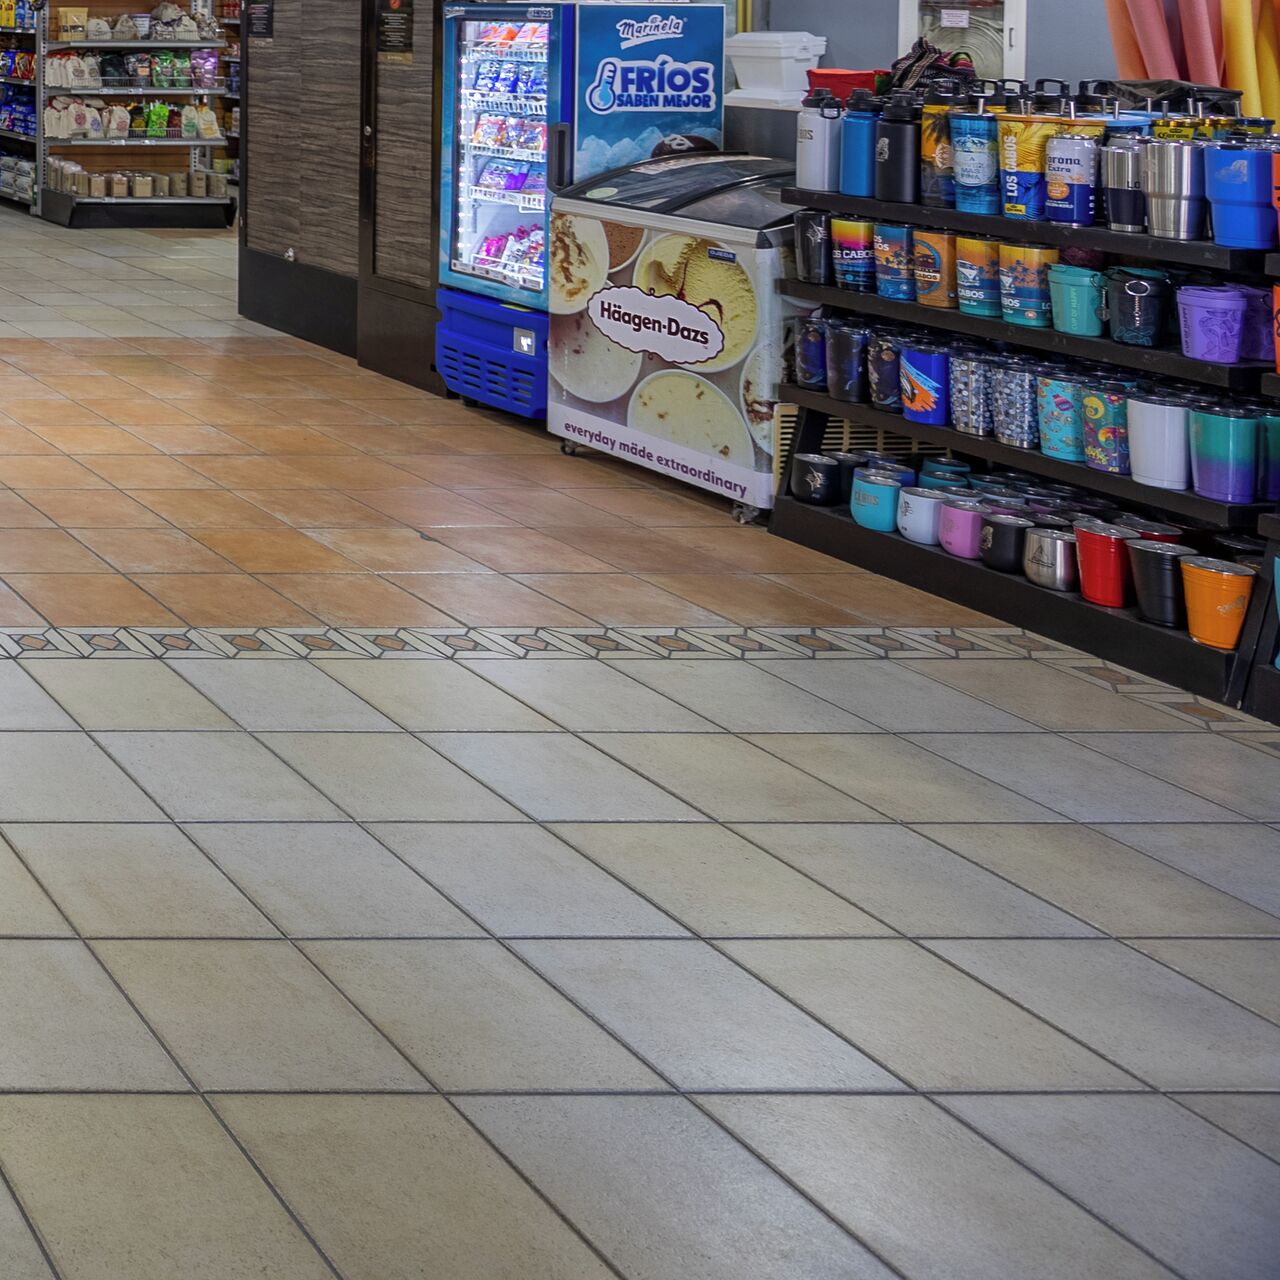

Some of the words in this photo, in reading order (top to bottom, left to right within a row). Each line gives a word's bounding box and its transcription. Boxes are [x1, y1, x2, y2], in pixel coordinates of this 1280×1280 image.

[618, 16, 682, 38] Marinela
[620, 59, 710, 94] FRÍOS
[616, 93, 660, 108] SABEN
[662, 93, 712, 108] MEJOR
[1157, 131, 1190, 140] Corona
[1004, 135, 1017, 172] CABOS
[1006, 175, 1018, 197] LOS
[600, 300, 709, 345] Häagen-Dazs
[564, 421, 616, 450] everyday
[619, 442, 654, 462] mäde
[656, 455, 747, 499] extraordinary
